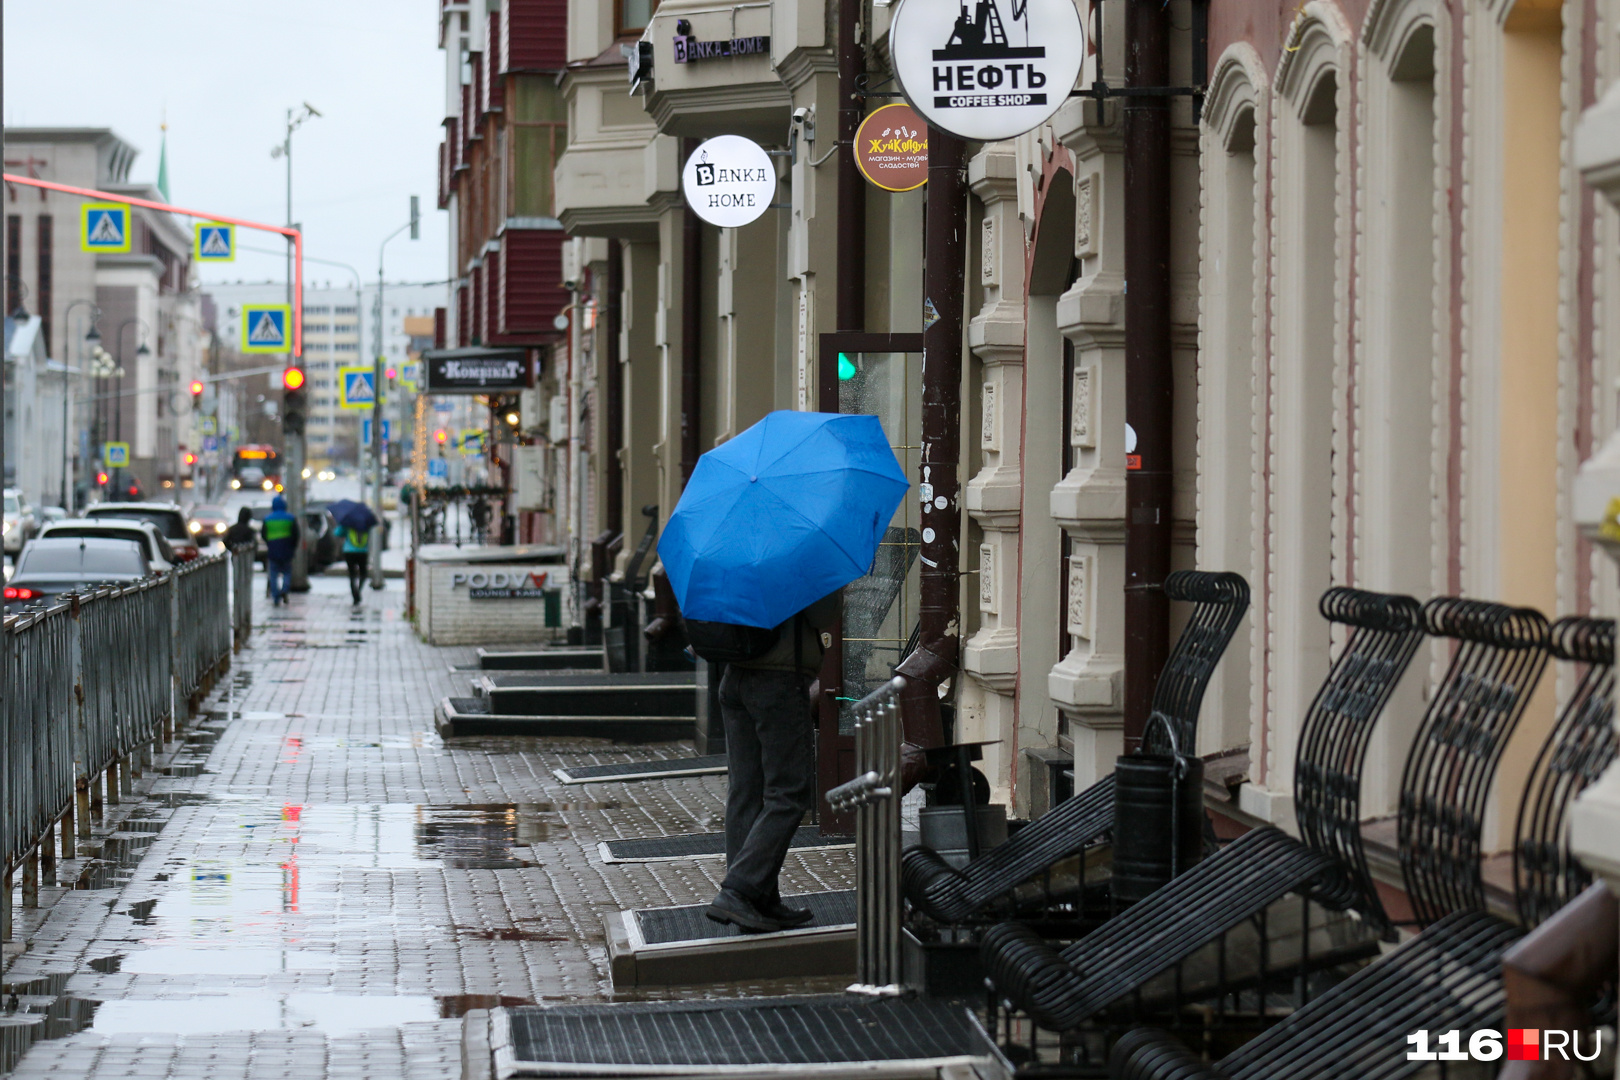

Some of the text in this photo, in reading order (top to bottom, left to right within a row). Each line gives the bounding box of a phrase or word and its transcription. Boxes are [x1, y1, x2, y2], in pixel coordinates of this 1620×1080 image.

[933, 64, 1047, 91] НЕФТЬ
[949, 94, 1031, 107] COFFEE SHOP
[696, 164, 767, 186] BANKA
[708, 193, 756, 208] HOME
[471, 589, 511, 598] LOUNGE
